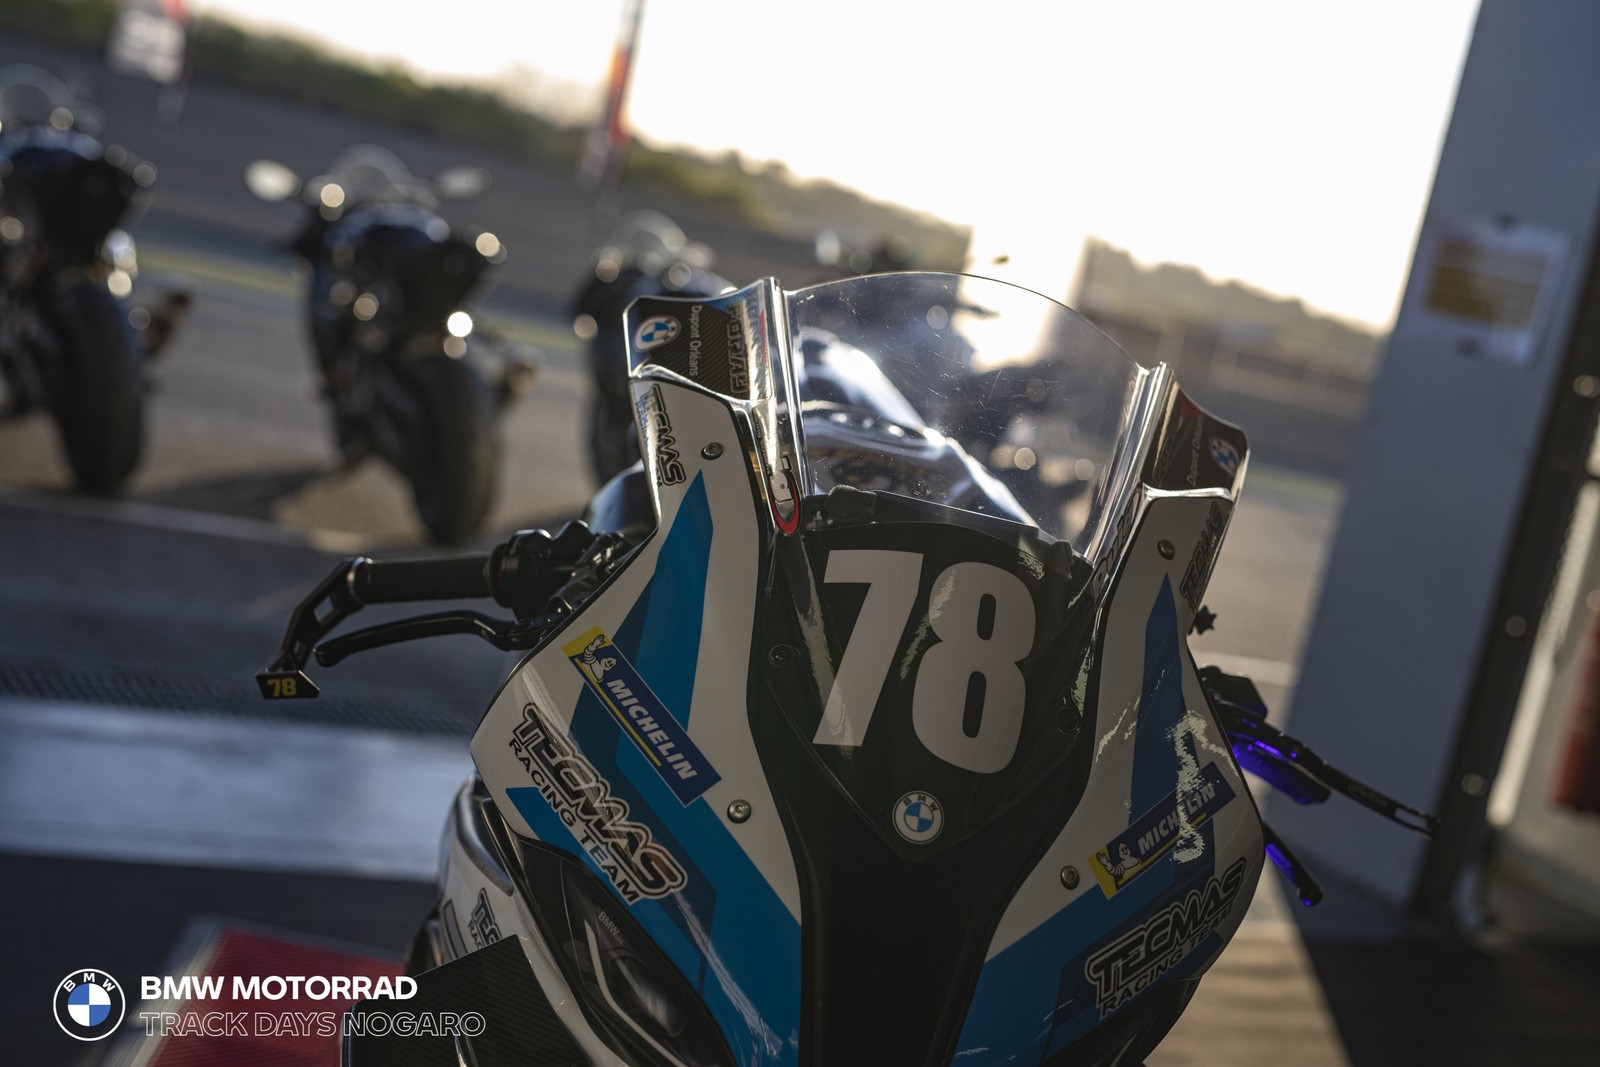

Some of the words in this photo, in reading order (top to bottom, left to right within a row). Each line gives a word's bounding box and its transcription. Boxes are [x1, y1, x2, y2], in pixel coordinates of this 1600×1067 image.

[688, 340, 702, 376] Orléans
[689, 304, 703, 338] Dupont
[640, 383, 686, 486] TECMAS
[267, 677, 297, 697] 78
[812, 549, 1036, 774] 78
[606, 678, 698, 781] MICHELIN
[508, 738, 576, 828] RACING
[580, 829, 640, 904] TEAM
[513, 702, 688, 900] TECMAS
[598, 911, 620, 937] BMW
[1084, 856, 1247, 1009] TECMAS
[1100, 953, 1182, 1021] RACING
[1188, 904, 1234, 951] TEAM
